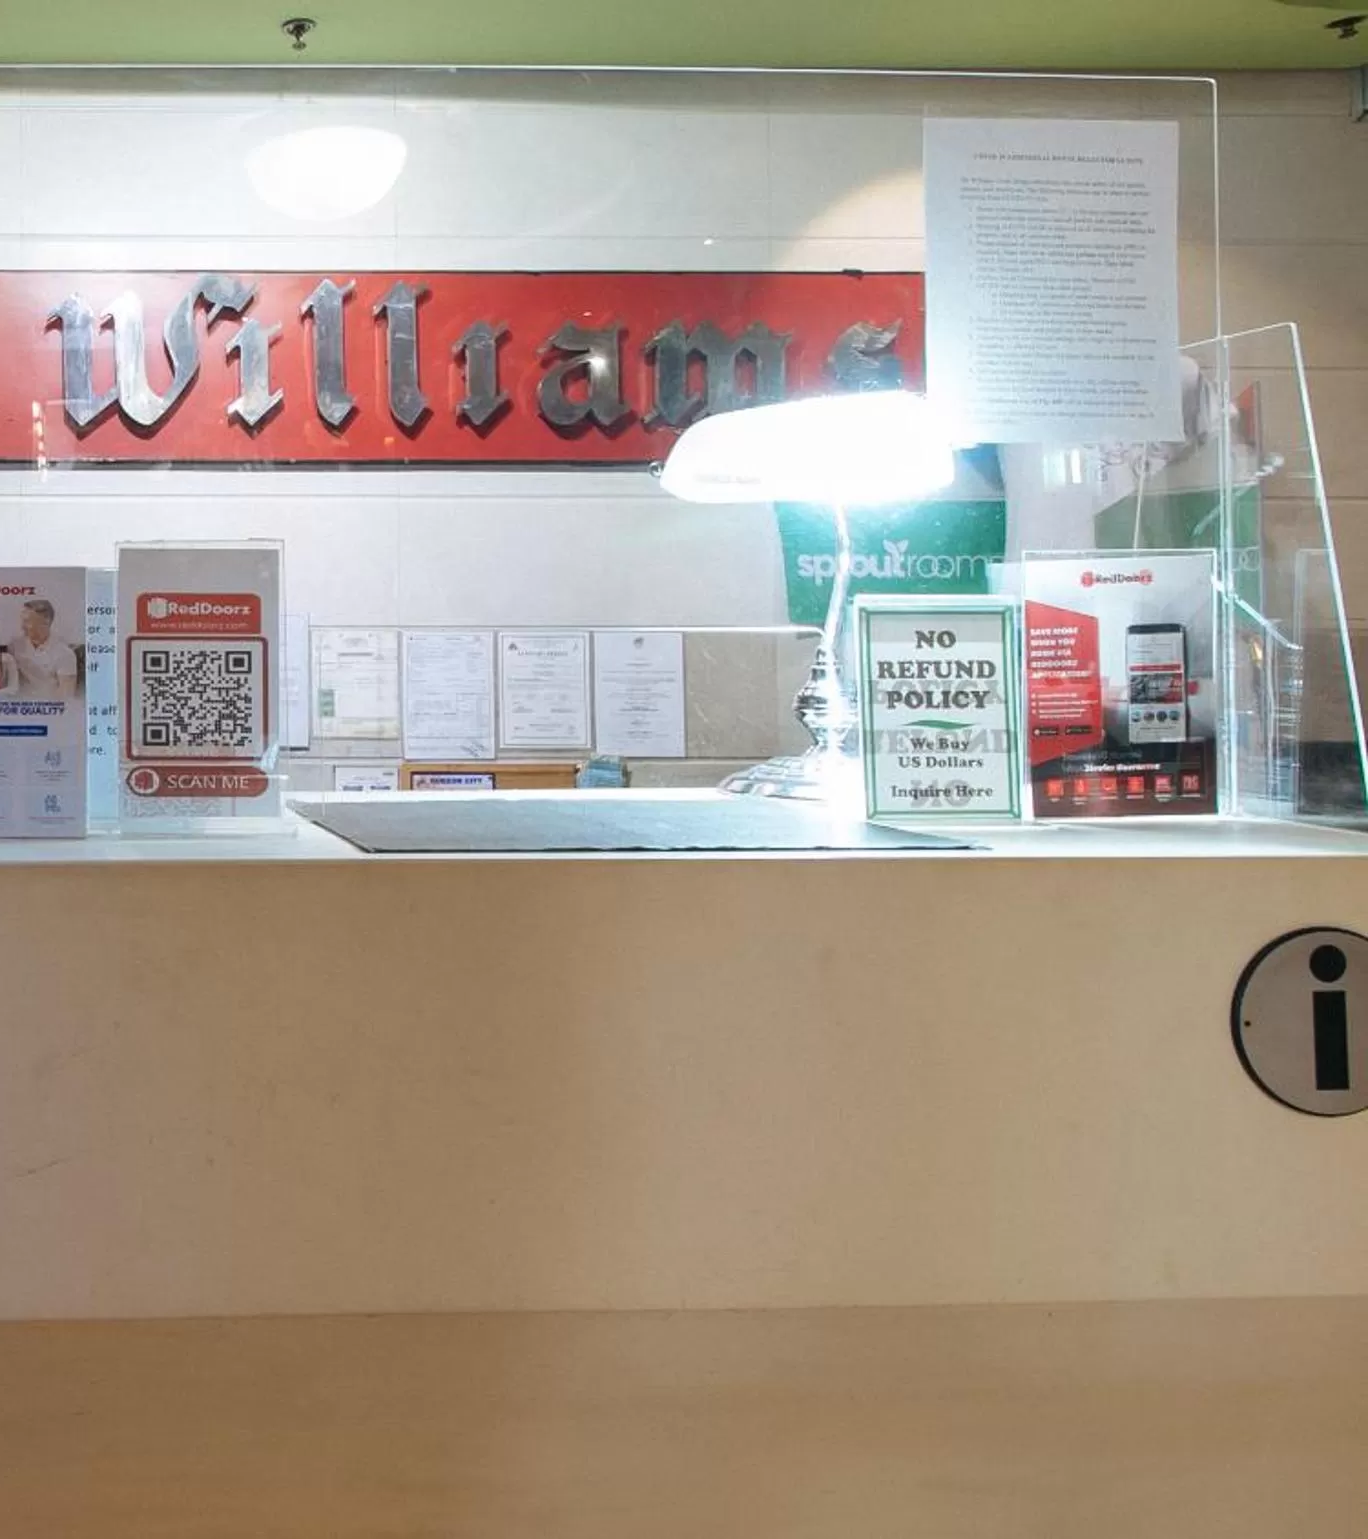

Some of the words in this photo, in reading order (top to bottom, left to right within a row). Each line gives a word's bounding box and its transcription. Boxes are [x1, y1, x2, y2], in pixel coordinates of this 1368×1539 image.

[44, 274, 902, 428] Williams
[1095, 573, 1153, 584] RedDoorz
[87, 606, 116, 616] erso
[169, 602, 253, 616] RedDoorz
[914, 630, 957, 649] NO
[87, 644, 116, 654] lease
[877, 660, 997, 680] REFUND
[885, 690, 991, 710] POLICY
[20, 706, 66, 716] QUALITY
[910, 738, 935, 750] We
[938, 738, 970, 753] Buy
[898, 756, 921, 769] US
[926, 756, 984, 769] Dollars
[167, 774, 218, 790] SCAN
[221, 774, 250, 789] ME
[464, 777, 482, 785] CITY
[891, 786, 952, 800] Inquire
[956, 785, 994, 798] Here
